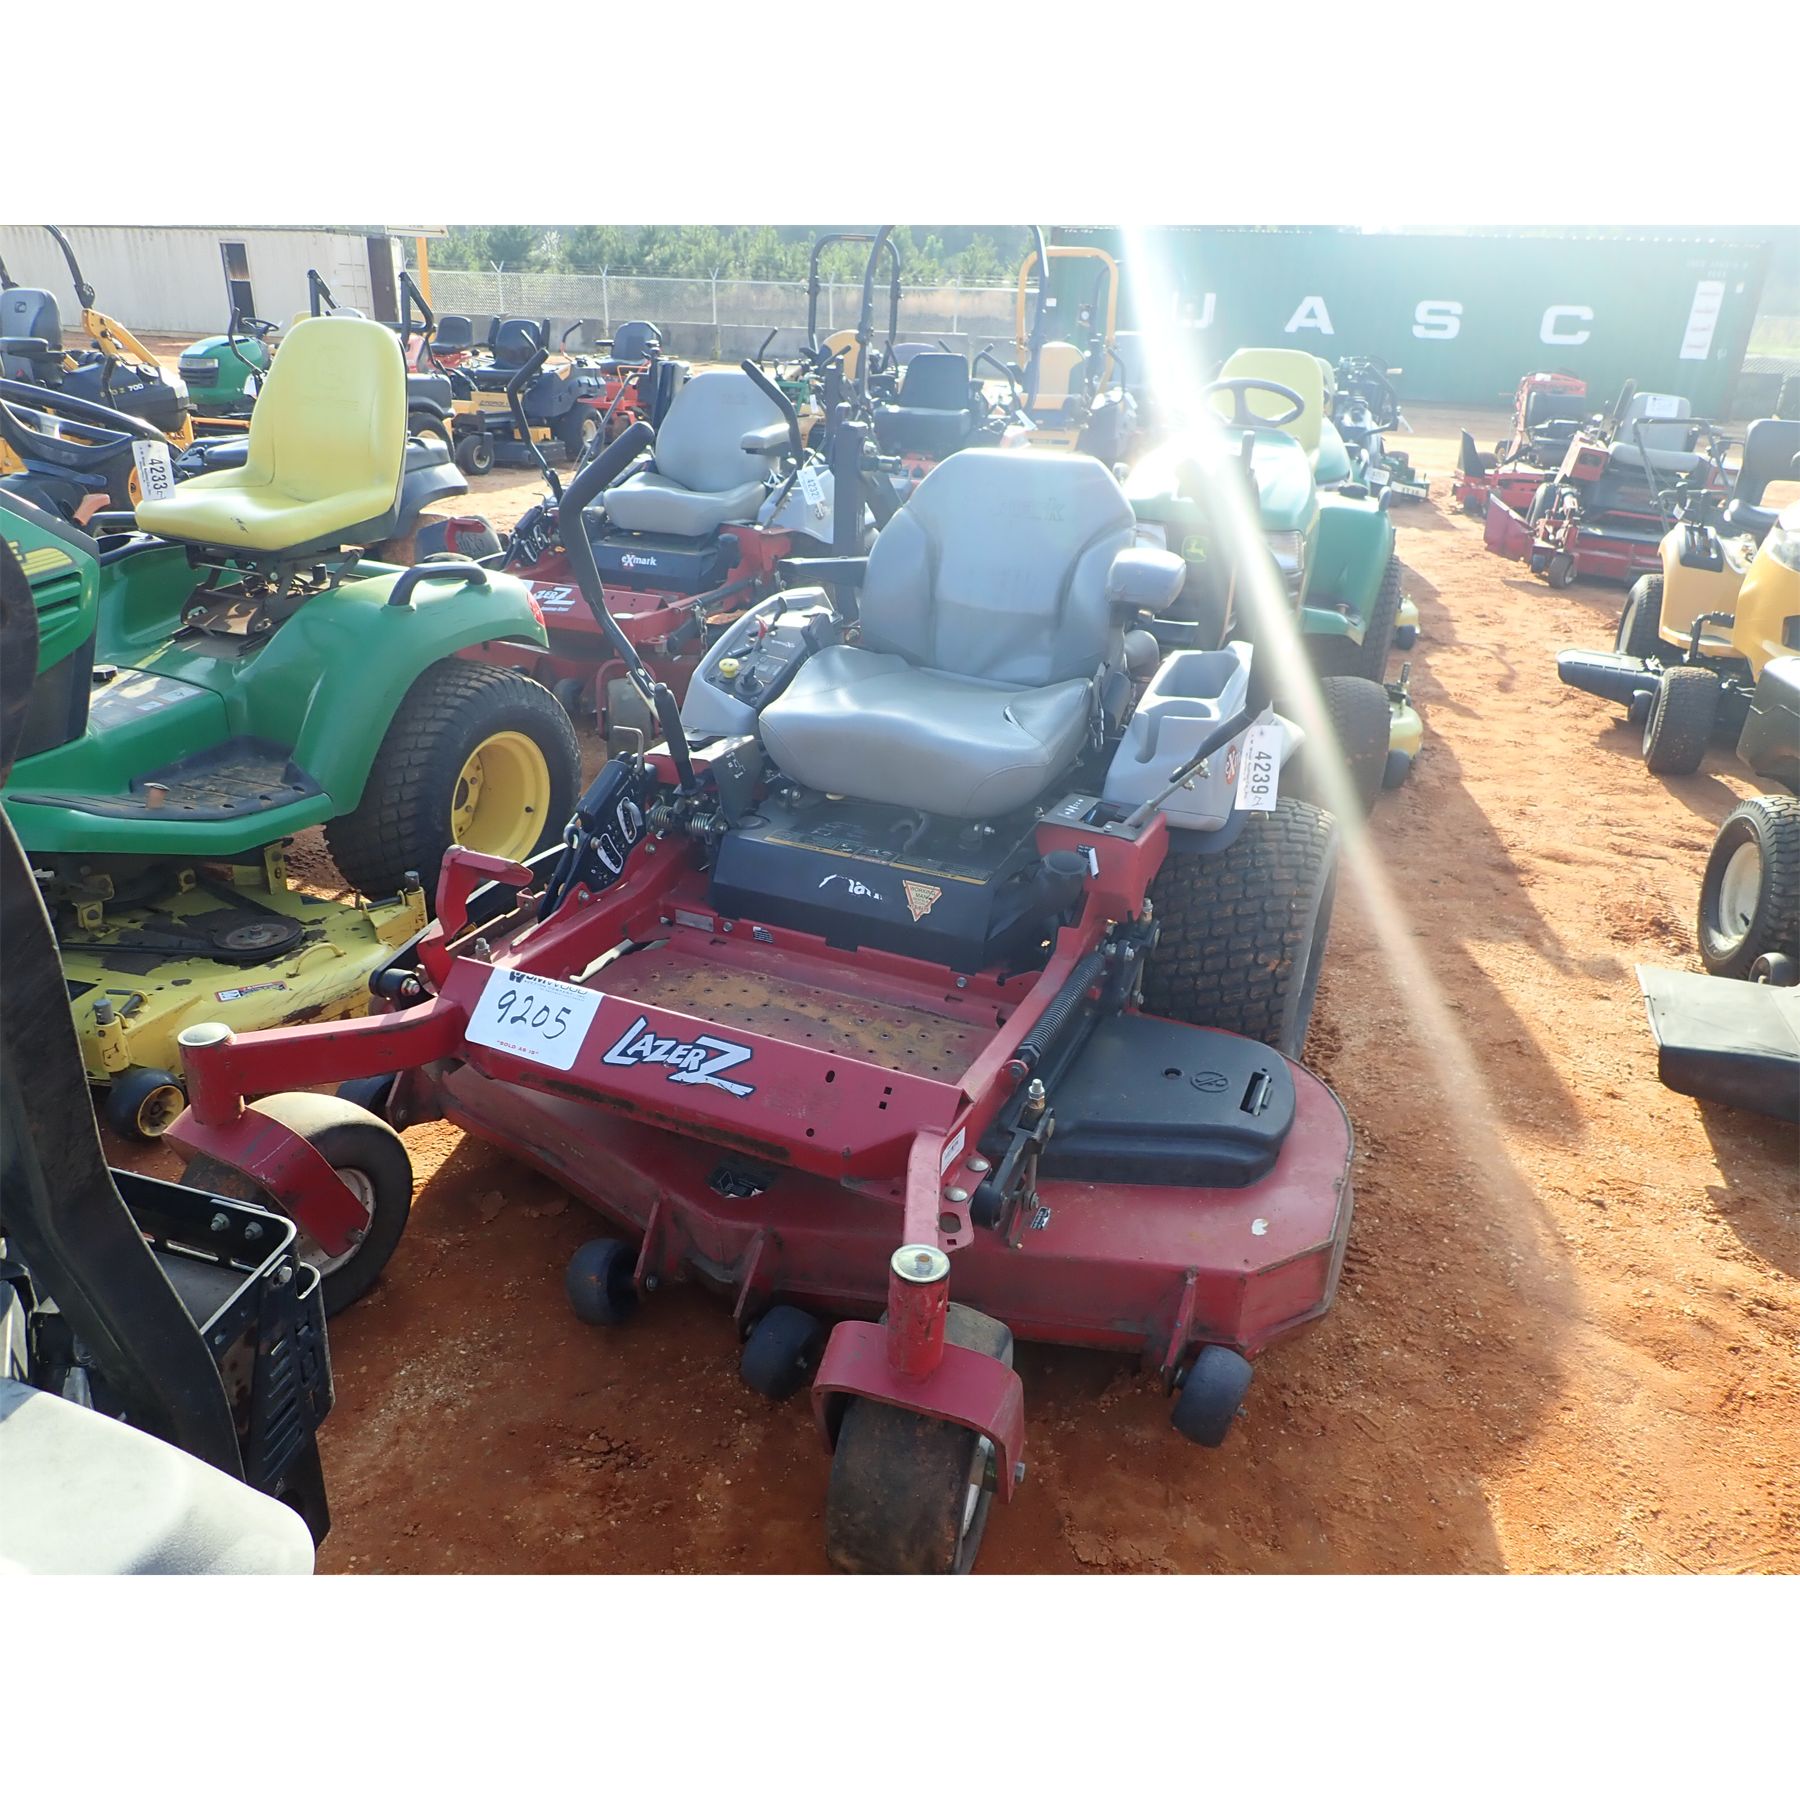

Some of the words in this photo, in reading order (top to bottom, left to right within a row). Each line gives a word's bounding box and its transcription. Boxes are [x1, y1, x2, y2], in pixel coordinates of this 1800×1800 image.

[148, 458, 169, 491] 4233
[621, 553, 657, 567] eXmark
[1251, 750, 1273, 795] 4239
[496, 989, 572, 1040] 9205
